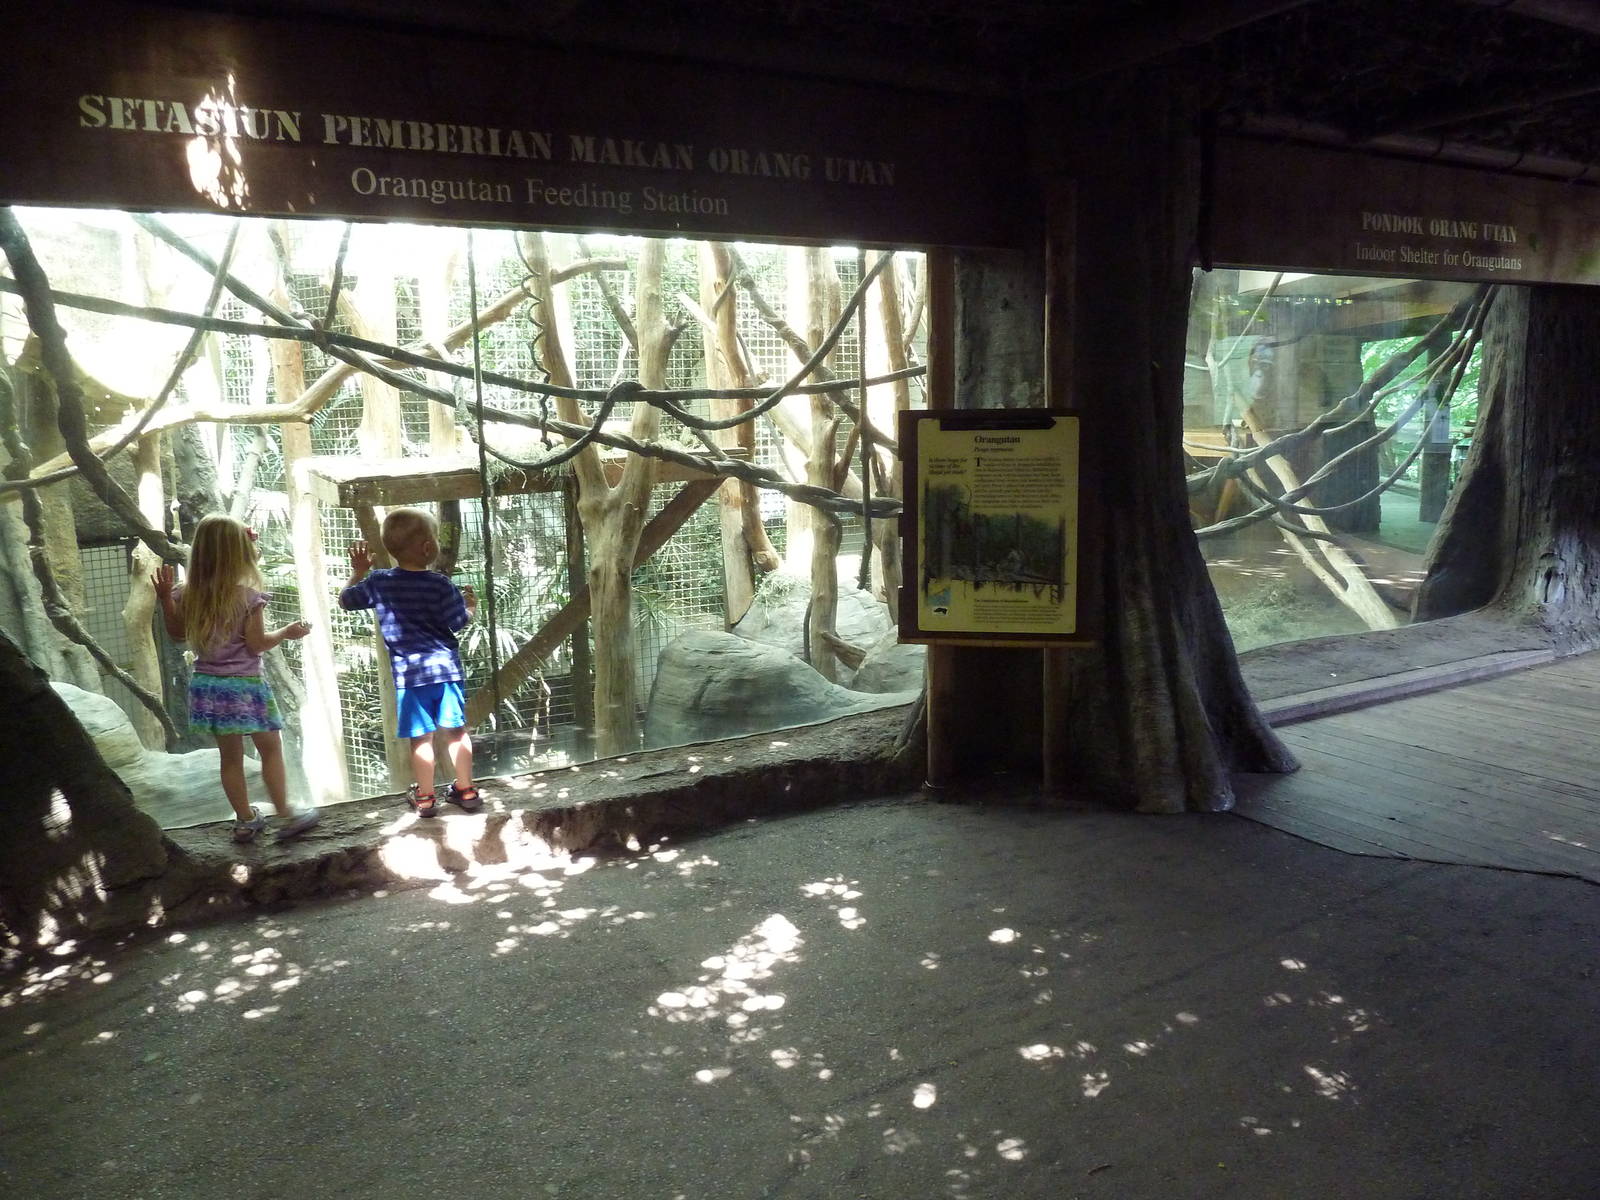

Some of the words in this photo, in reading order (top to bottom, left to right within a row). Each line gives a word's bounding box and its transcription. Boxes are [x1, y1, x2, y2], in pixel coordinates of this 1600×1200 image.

[78, 94, 301, 142] SETASIUN
[321, 113, 551, 160] PEMBERIAN
[571, 133, 695, 171] MAKAN
[709, 148, 811, 181] ORANG
[825, 159, 895, 186] UTAN
[351, 167, 512, 203] Orangutan
[525, 179, 631, 214] Feeding
[643, 187, 728, 215] Station
[1361, 212, 1424, 234] PONDOK
[1429, 219, 1478, 240] ORANG
[1483, 225, 1518, 243] UTAN
[1354, 243, 1397, 261] Indoor
[1400, 247, 1439, 265] Shelter
[1443, 250, 1459, 266] for
[1462, 252, 1522, 271] Orangutans
